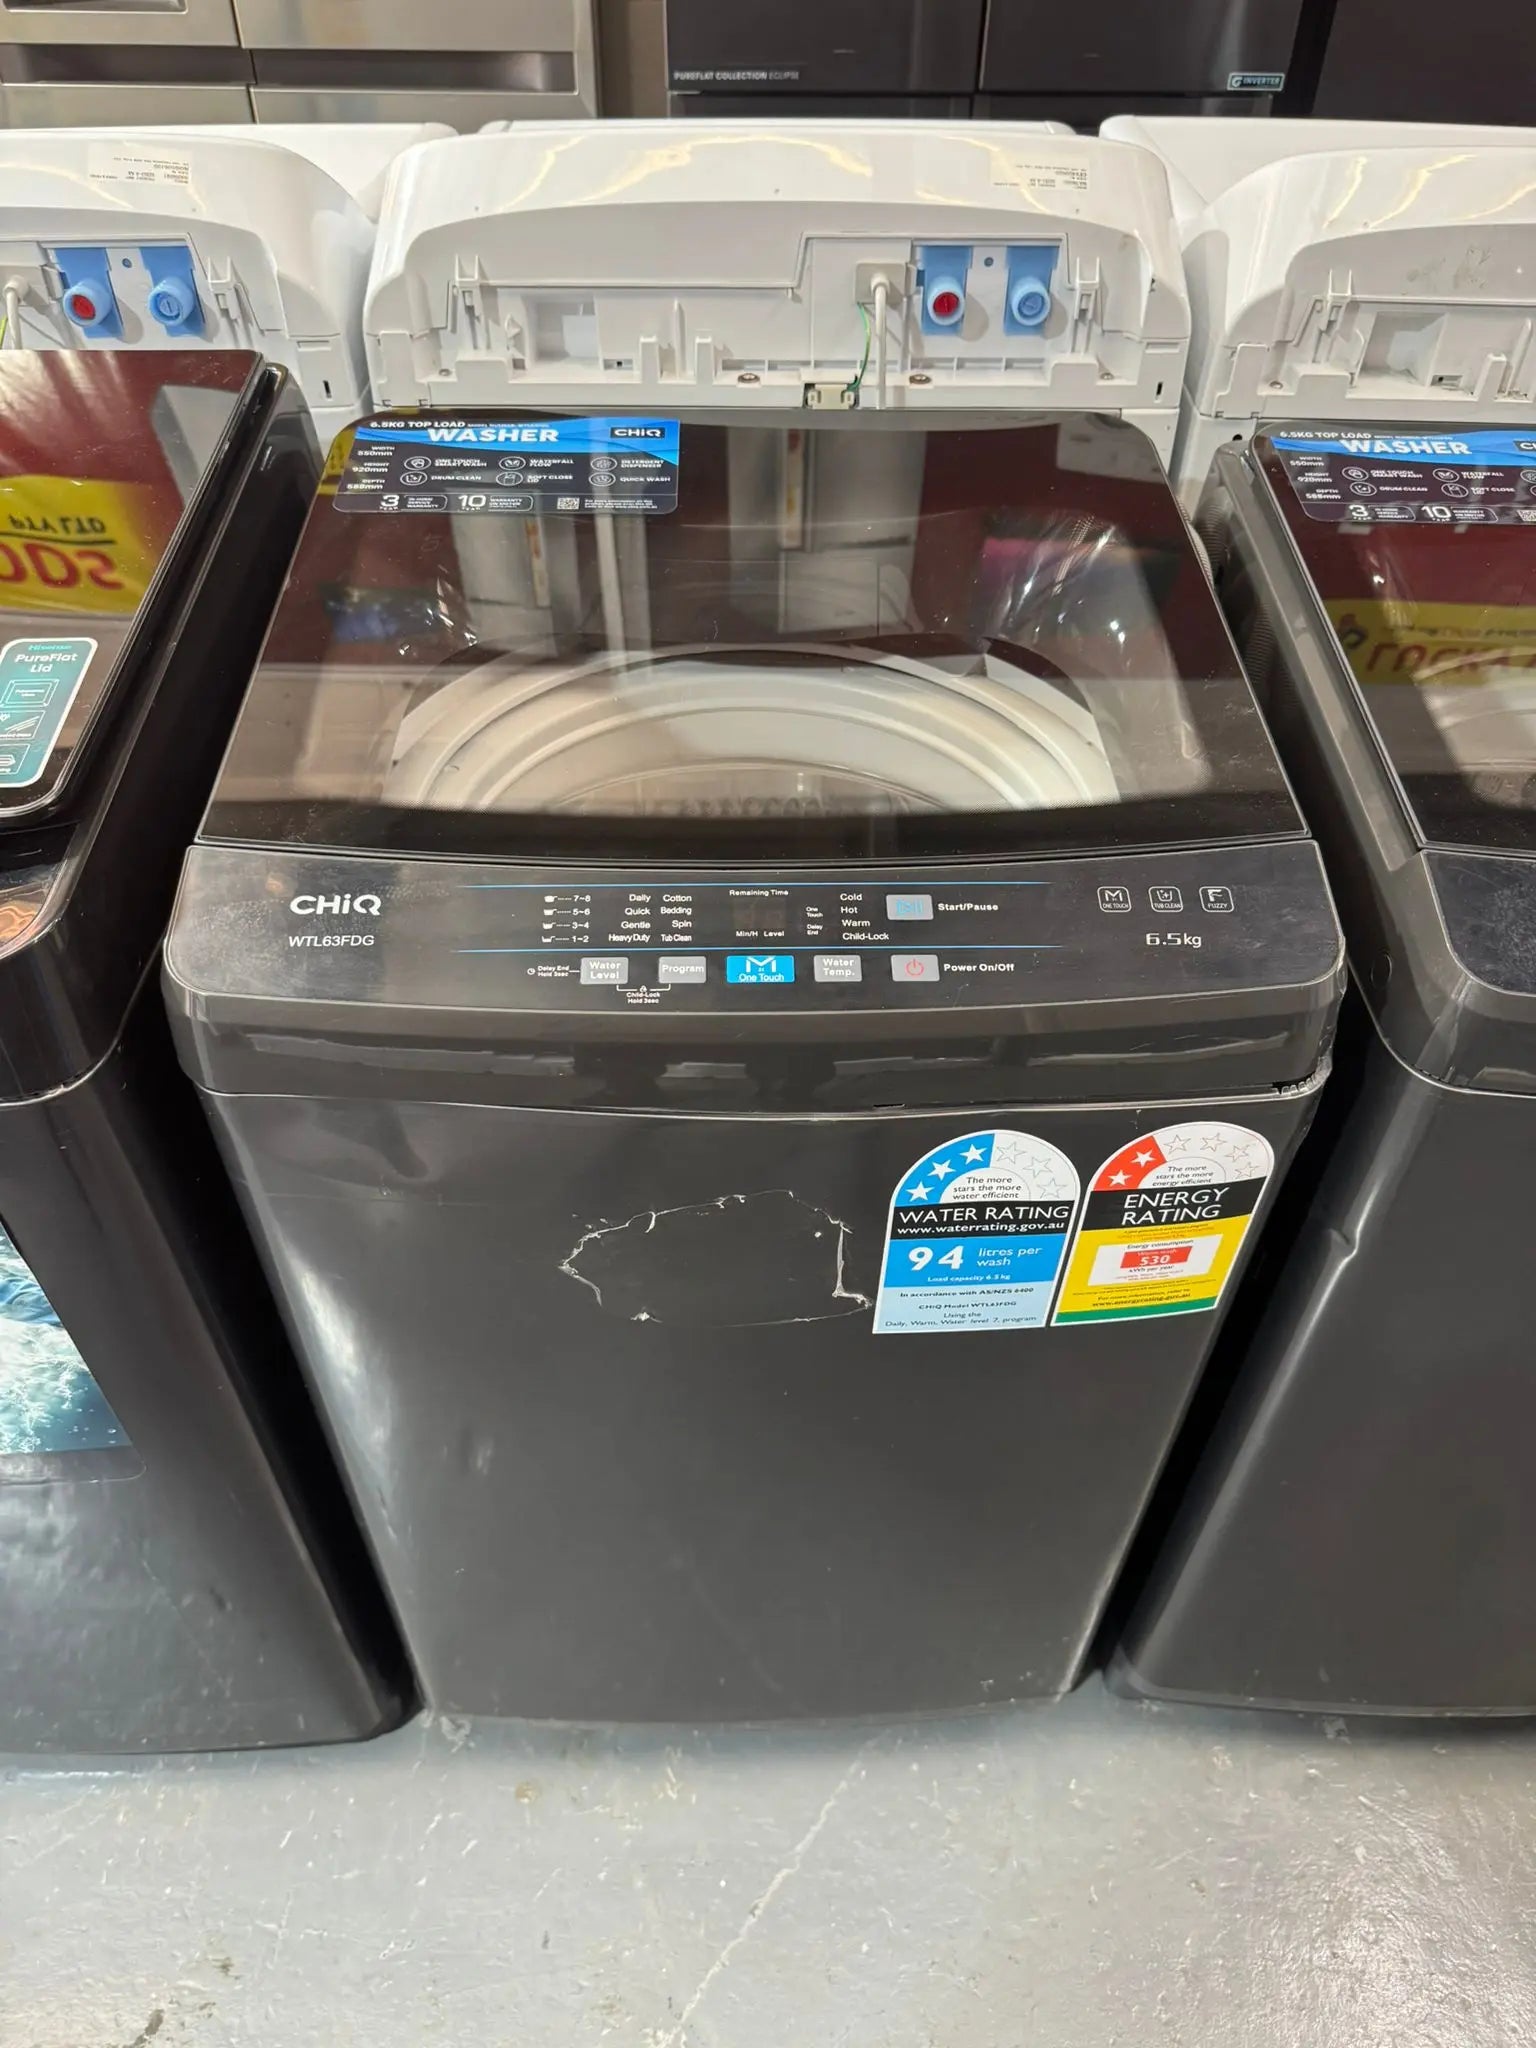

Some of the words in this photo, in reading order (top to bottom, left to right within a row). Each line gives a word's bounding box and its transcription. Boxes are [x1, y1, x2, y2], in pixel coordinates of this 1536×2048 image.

[715, 72, 767, 80] COLLECTION
[1243, 77, 1280, 85] INVERTER
[428, 428, 559, 442] WASHER
[1338, 440, 1472, 454] WASHER
[380, 494, 400, 507] 3
[458, 494, 486, 508] 10
[1348, 504, 1368, 517] 3
[1421, 506, 1452, 518] 10
[14, 652, 78, 662] PureFlat
[30, 664, 52, 672] Lid
[629, 894, 651, 903] Daily
[624, 907, 650, 915] Quick
[660, 907, 692, 915] Bedding
[938, 903, 999, 911] Start/Pause
[621, 921, 651, 929] Gentle
[672, 920, 692, 928] Spin
[288, 935, 374, 947] WTL63FDG
[608, 934, 633, 943] Heavy
[633, 934, 650, 942] Duty
[842, 932, 889, 940] Child-Lock
[1146, 932, 1201, 948] 6.5kg
[662, 964, 704, 973] Program
[823, 968, 855, 977] Temp.
[590, 971, 620, 979] Level
[739, 974, 757, 982] One
[758, 974, 784, 982] Touch
[1124, 1187, 1230, 1209] ENERGY
[900, 1208, 977, 1223] WATER
[985, 1205, 1070, 1220] RATING
[1122, 1204, 1222, 1226] RATING
[897, 1222, 1064, 1234] www.waterrating.gov.au
[1151, 1240, 1194, 1248] consumption
[979, 1248, 1013, 1257] litres
[1017, 1247, 1043, 1257] per
[908, 1245, 964, 1271] 94
[977, 1257, 1011, 1267] wash
[1140, 1254, 1171, 1266] 530
